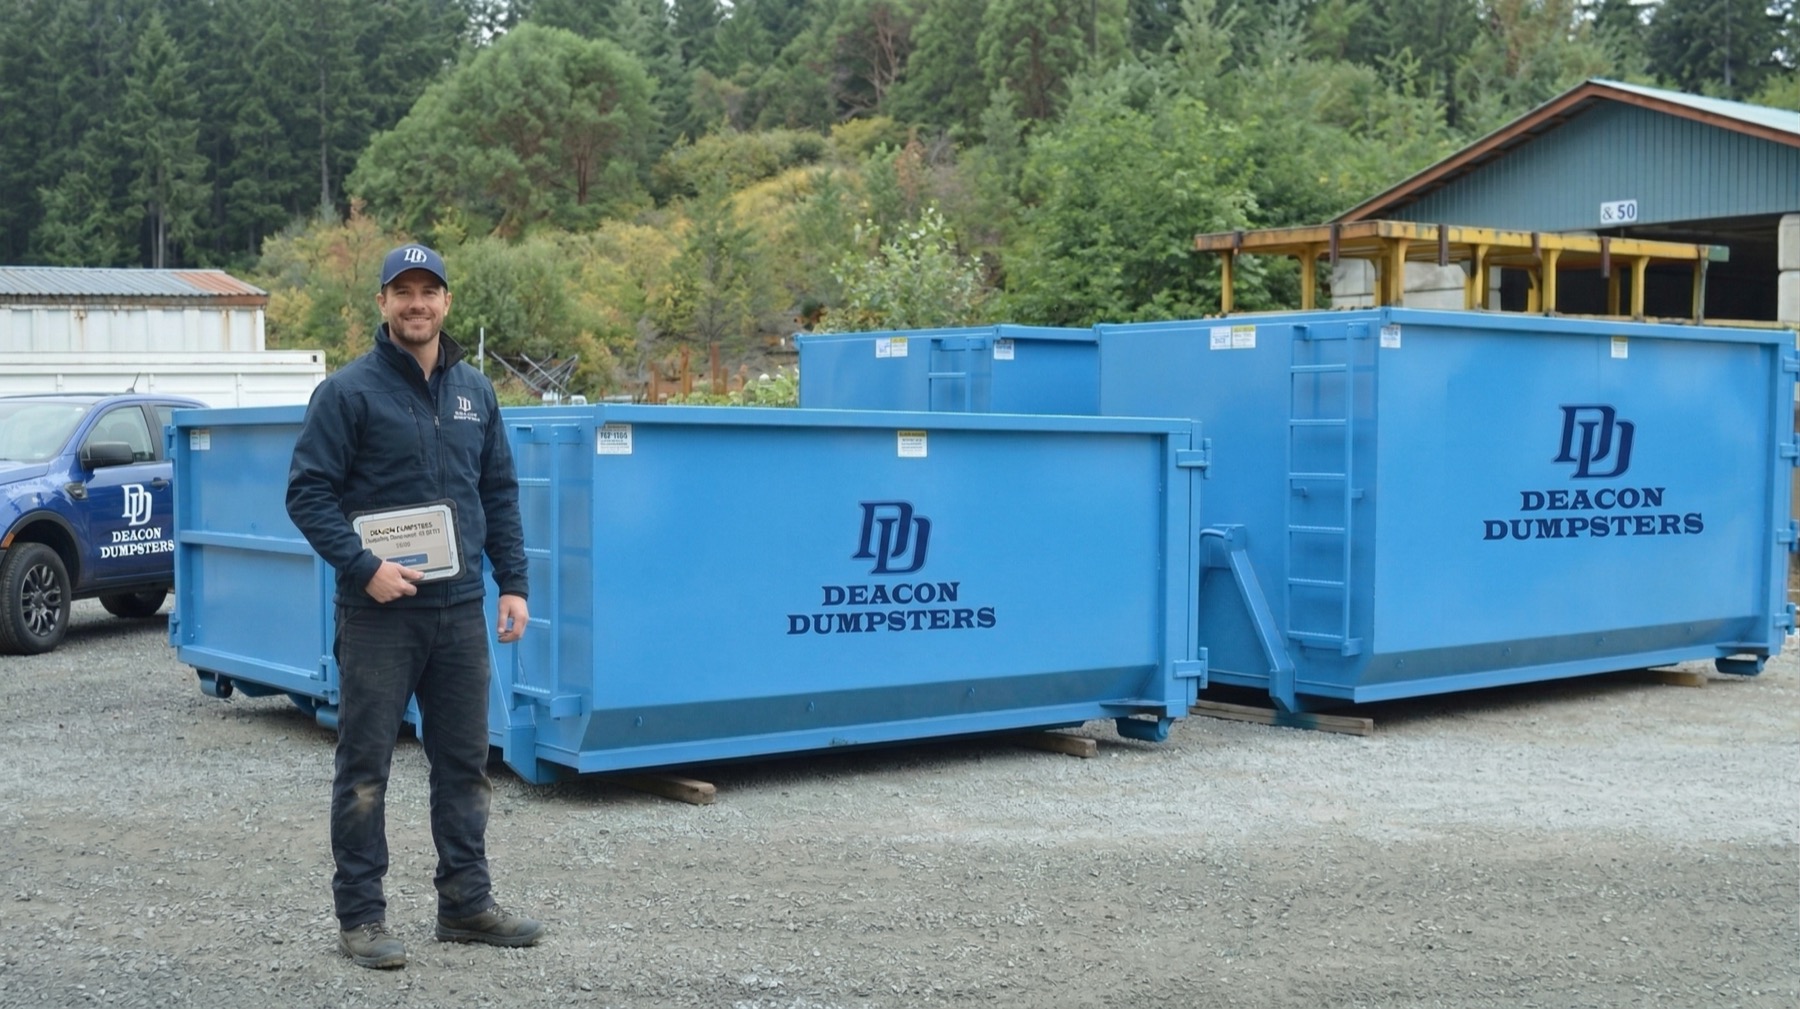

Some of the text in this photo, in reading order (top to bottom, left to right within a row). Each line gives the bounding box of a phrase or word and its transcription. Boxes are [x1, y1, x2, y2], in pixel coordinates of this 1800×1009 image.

[1602, 203, 1635, 221] & 50
[1551, 403, 1636, 480] DD
[121, 483, 152, 526] DD
[1519, 487, 1666, 511] DEACON
[111, 527, 162, 543] DEACON
[851, 500, 932, 575] DD
[1482, 512, 1705, 541] DUMPSTERS
[100, 539, 175, 559] DUMPSTERS
[821, 581, 961, 606] DEACON
[786, 606, 997, 636] DUMPSTERS
